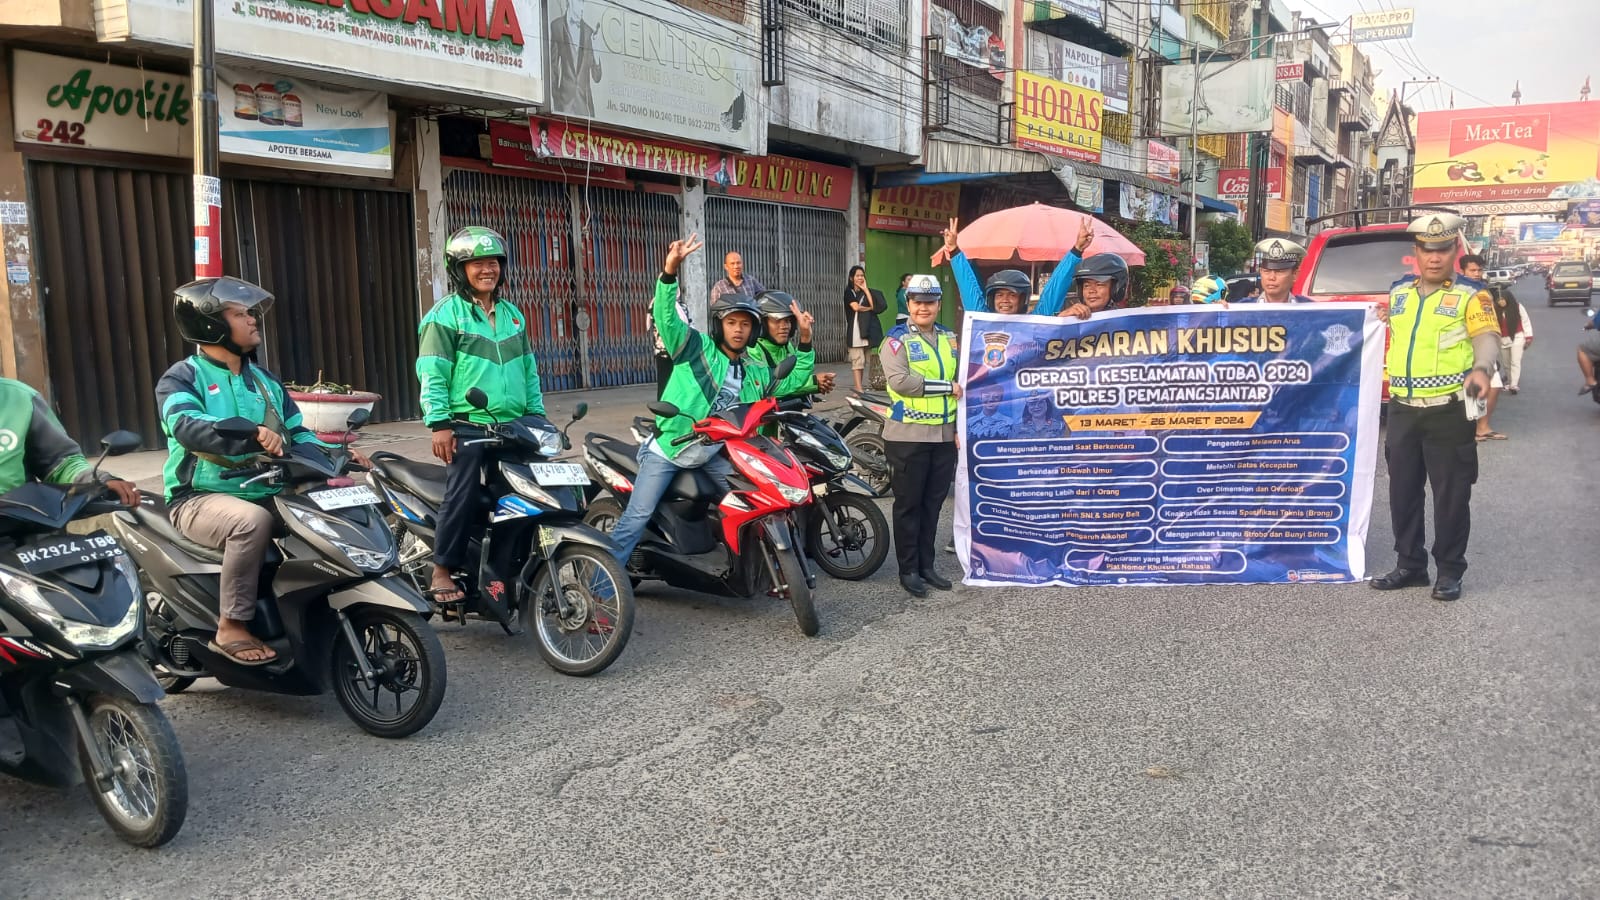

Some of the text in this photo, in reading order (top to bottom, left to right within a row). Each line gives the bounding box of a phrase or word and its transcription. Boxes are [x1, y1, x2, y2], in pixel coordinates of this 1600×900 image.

[249, 5, 295, 23] SUTOMO
[317, 19, 336, 32] 242
[601, 6, 722, 81] CENTRO
[1065, 48, 1100, 66] NAPOLLY
[46, 69, 191, 126] Apotik
[1022, 78, 1100, 131] HORAS
[316, 103, 363, 119] New Look
[620, 103, 648, 116] SUTOMO
[37, 119, 86, 145] 242
[1028, 123, 1093, 148] PERABOT
[1465, 121, 1533, 142] MaxTea
[268, 144, 332, 160] APOTEK BERSAMA
[560, 128, 638, 168] CENTRO
[642, 144, 709, 178] TEXTILE
[737, 160, 833, 198] BANDUNG
[1440, 188, 1482, 198] refreshing
[1501, 188, 1522, 197] tasty
[1524, 186, 1548, 195] drink
[1045, 326, 1286, 361] SASARAN KHUSUS
[1020, 364, 1307, 387] OPERASI KESELAMATAN TOBA 2024
[1059, 386, 1269, 404] POLRES PEMATANGSIANTAR
[1095, 418, 1137, 426] MARET
[1169, 417, 1211, 425] MARET
[1215, 416, 1245, 424] 2024
[996, 445, 1047, 454] Menggunakan
[1207, 440, 1250, 448] Pengendara
[1283, 437, 1300, 445] Arus
[1018, 468, 1059, 476] Berkendara
[1259, 462, 1298, 470] Kecepatan
[1010, 490, 1054, 498] Berbonceng
[1097, 488, 1120, 496] Orang
[1102, 511, 1124, 520] Safety
[1305, 509, 1333, 518] (Brong)
[1101, 532, 1128, 540] Alkohol
[1165, 530, 1215, 539] Menggunakan
[1217, 530, 1242, 538] Lampu
[1269, 530, 1283, 538] dan
[1284, 531, 1306, 539] Bunyi
[1121, 563, 1146, 571] Nomor
[1148, 563, 1175, 571] Khusus
[1143, 556, 1161, 564] yang
[313, 562, 339, 577] HONDA
[24, 639, 53, 659] HONDA
